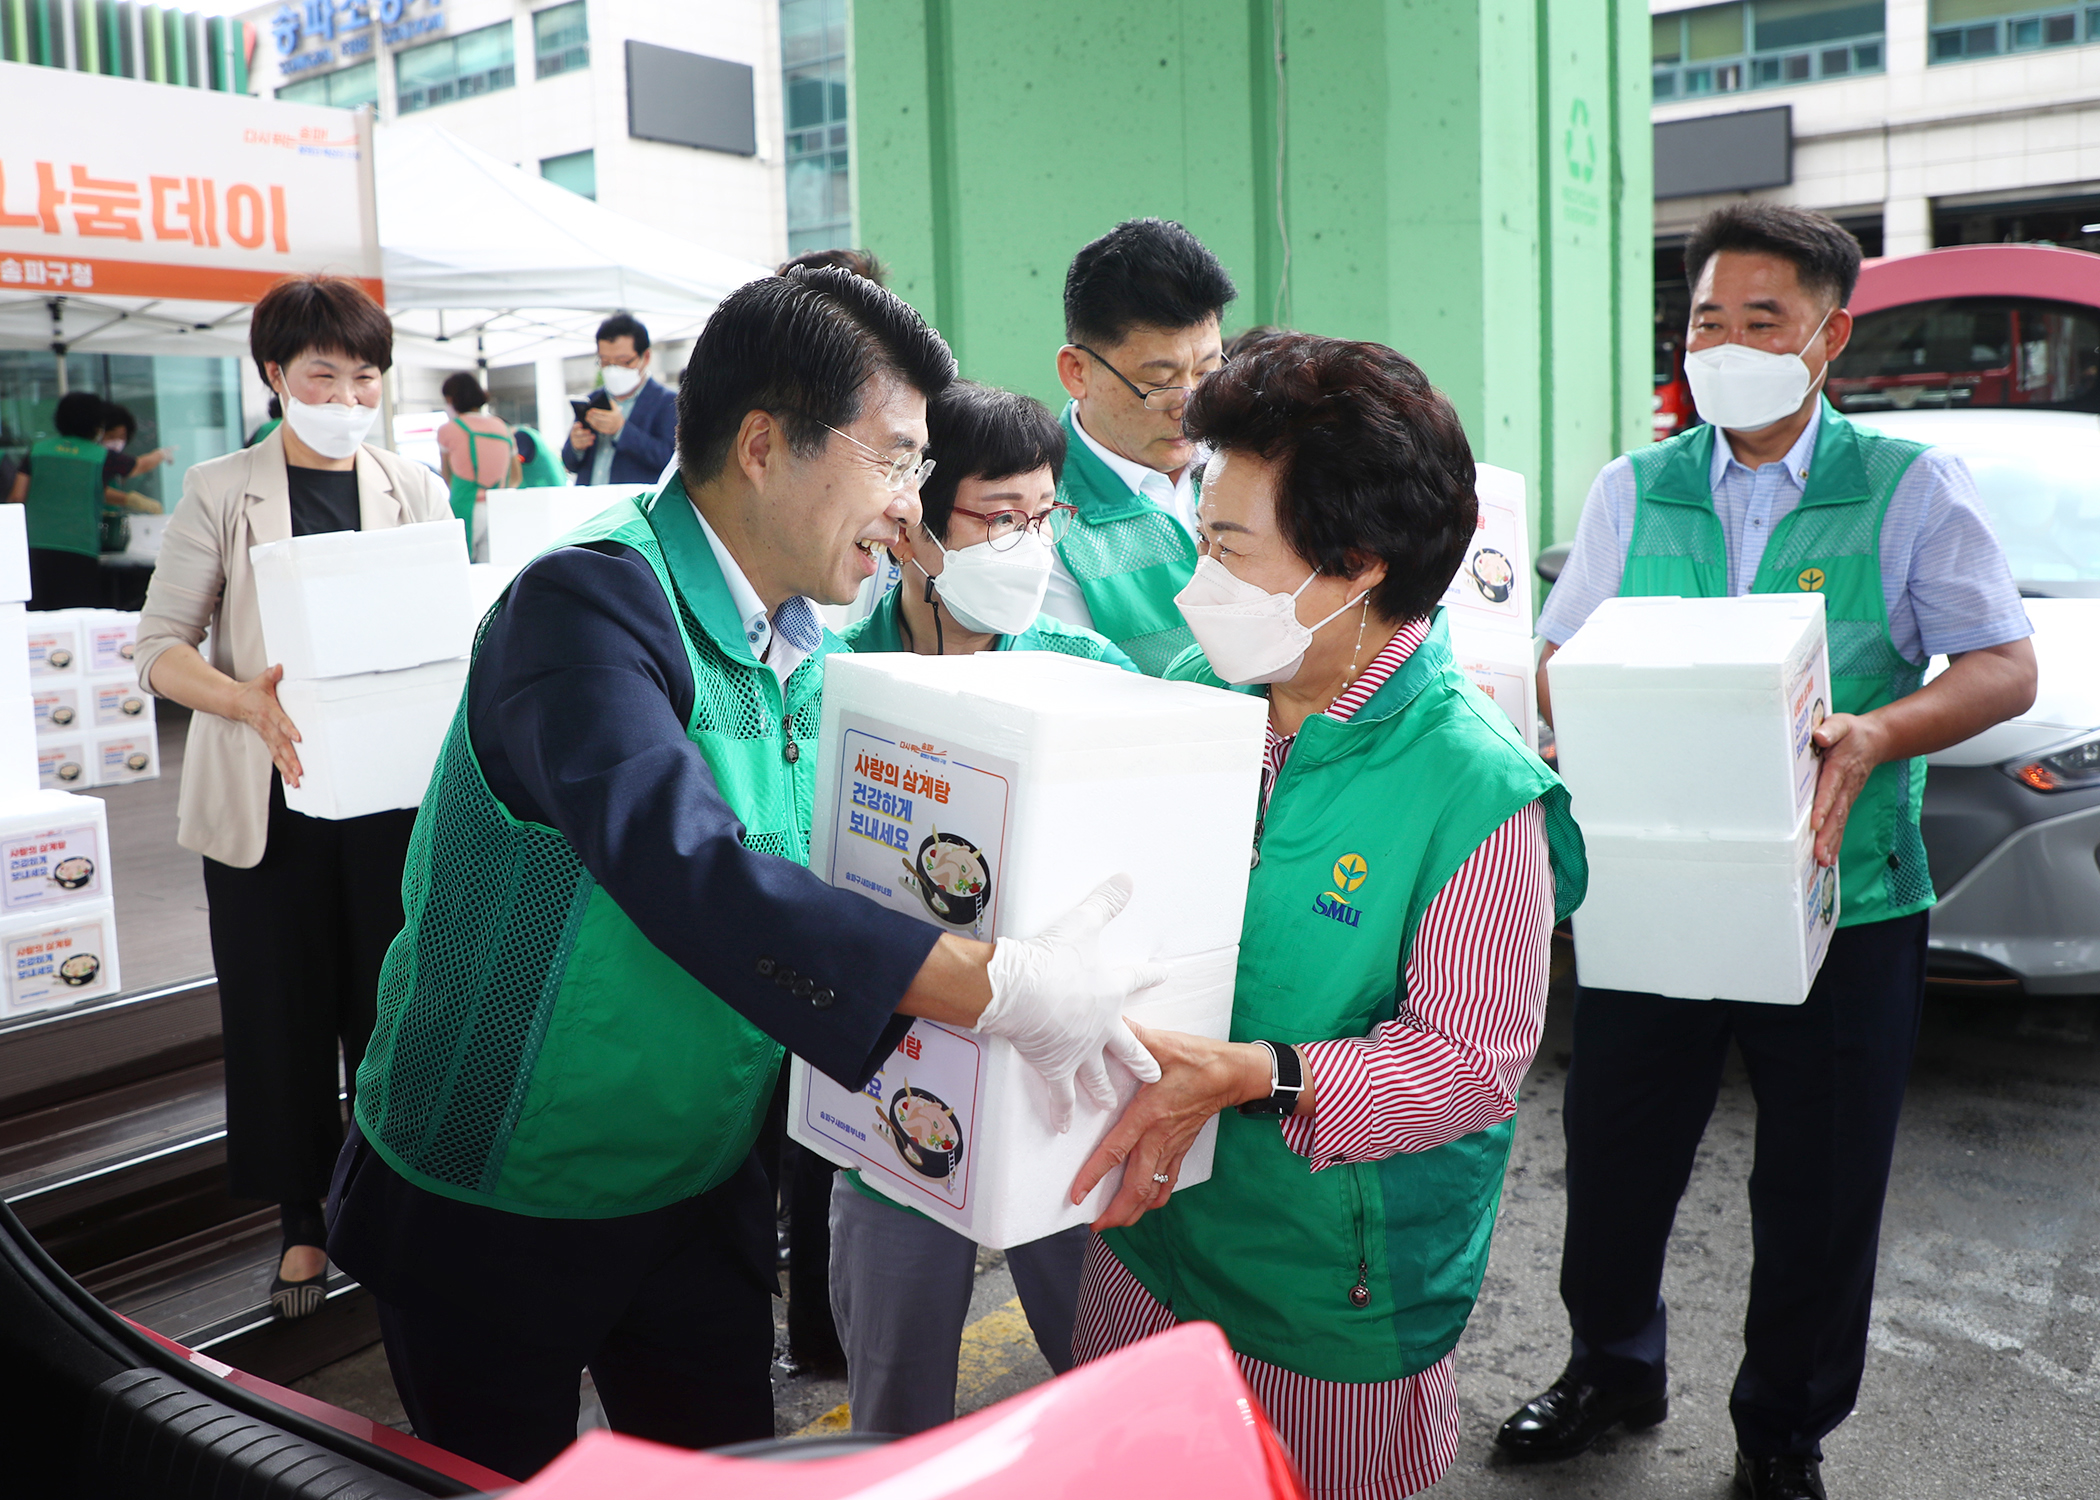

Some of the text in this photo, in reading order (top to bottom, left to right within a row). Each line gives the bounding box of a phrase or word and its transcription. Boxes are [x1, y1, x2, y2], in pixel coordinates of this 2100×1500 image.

[0, 158, 290, 254] 나눔데이
[0, 258, 93, 288] 송파구청
[855, 753, 951, 804] 사랑의 삼계탕
[853, 781, 913, 822] 건강하게
[850, 810, 909, 852] 보내세요
[1312, 893, 1363, 927] SMU
